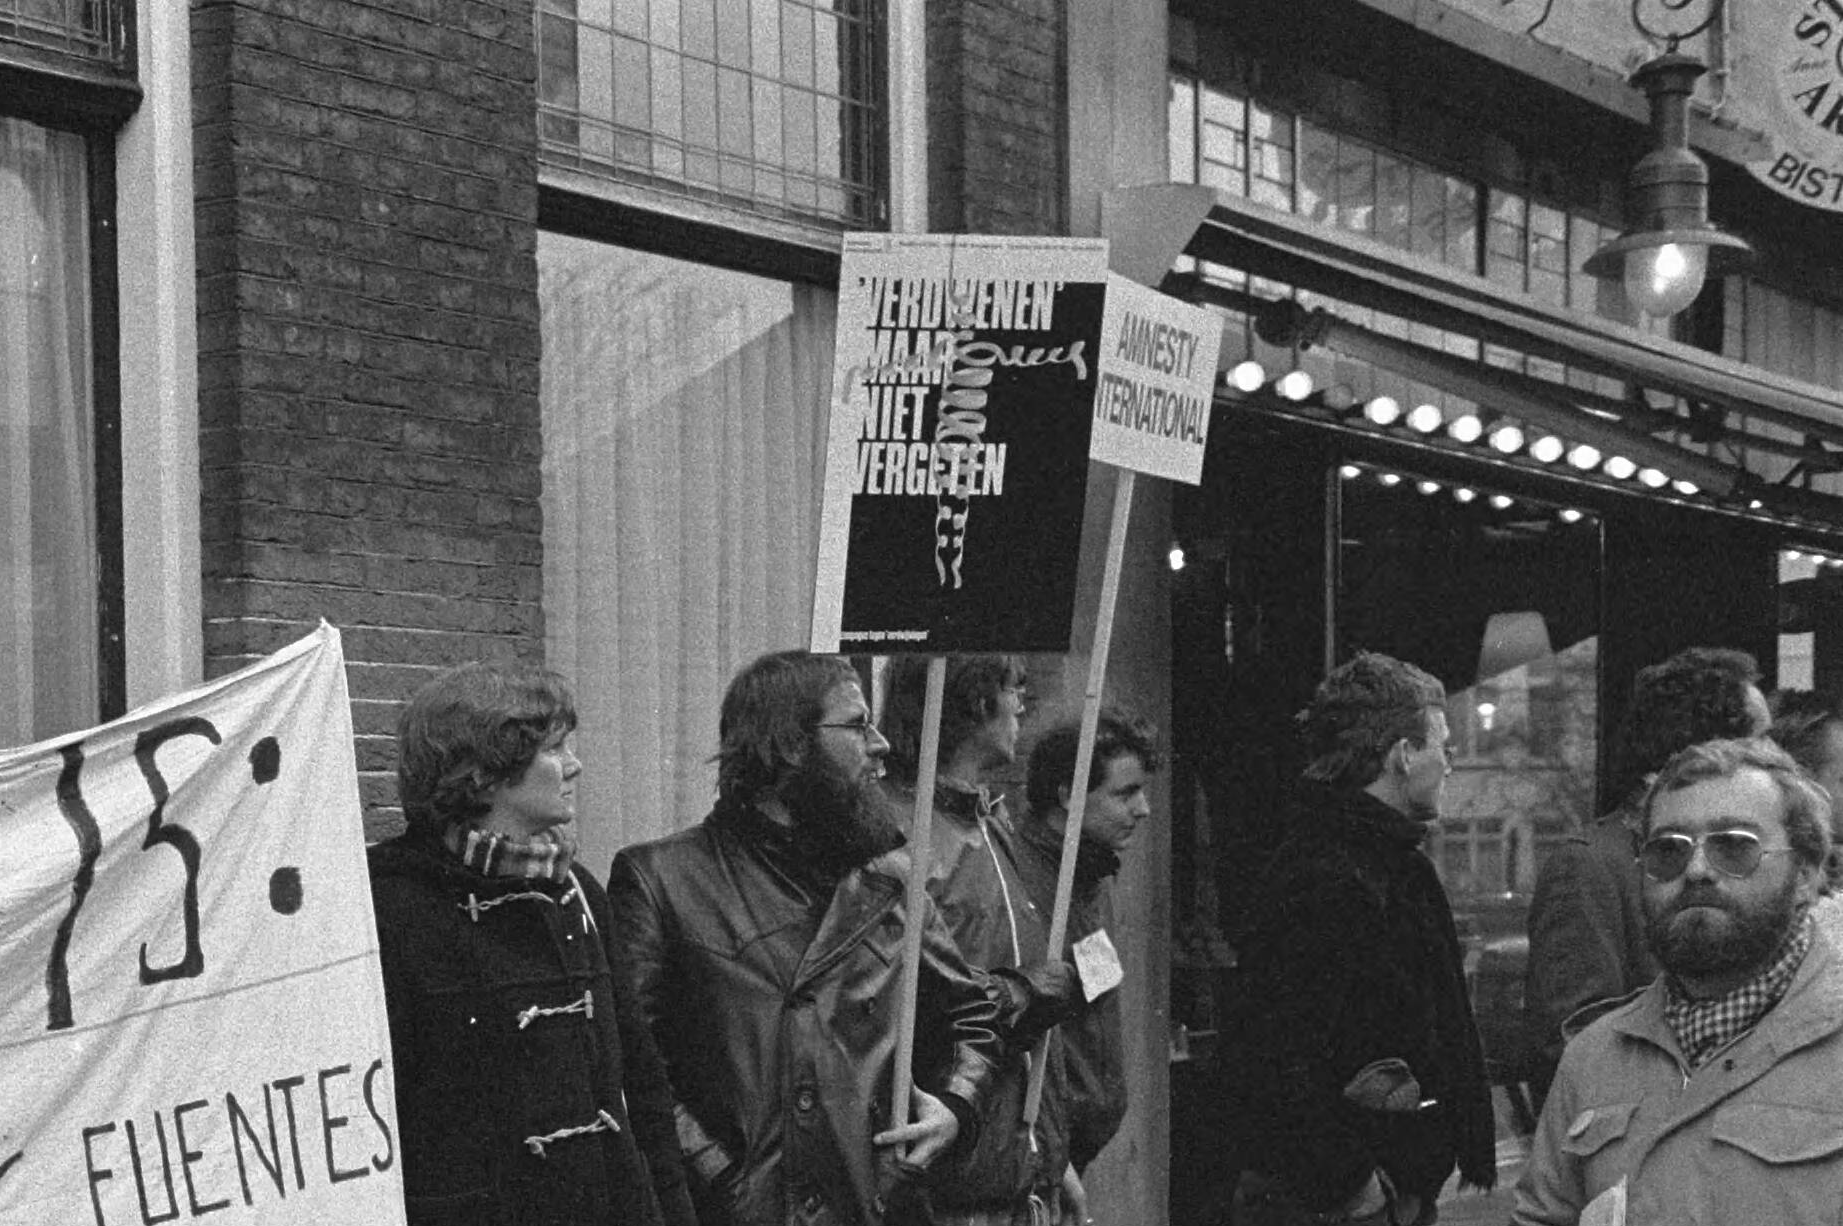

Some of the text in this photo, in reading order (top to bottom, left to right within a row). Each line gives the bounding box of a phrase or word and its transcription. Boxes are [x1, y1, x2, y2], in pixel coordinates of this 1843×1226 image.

[1116, 311, 1200, 380] AMNESTY
[857, 385, 930, 441] NIET
[854, 441, 1007, 496] VERGETEN
